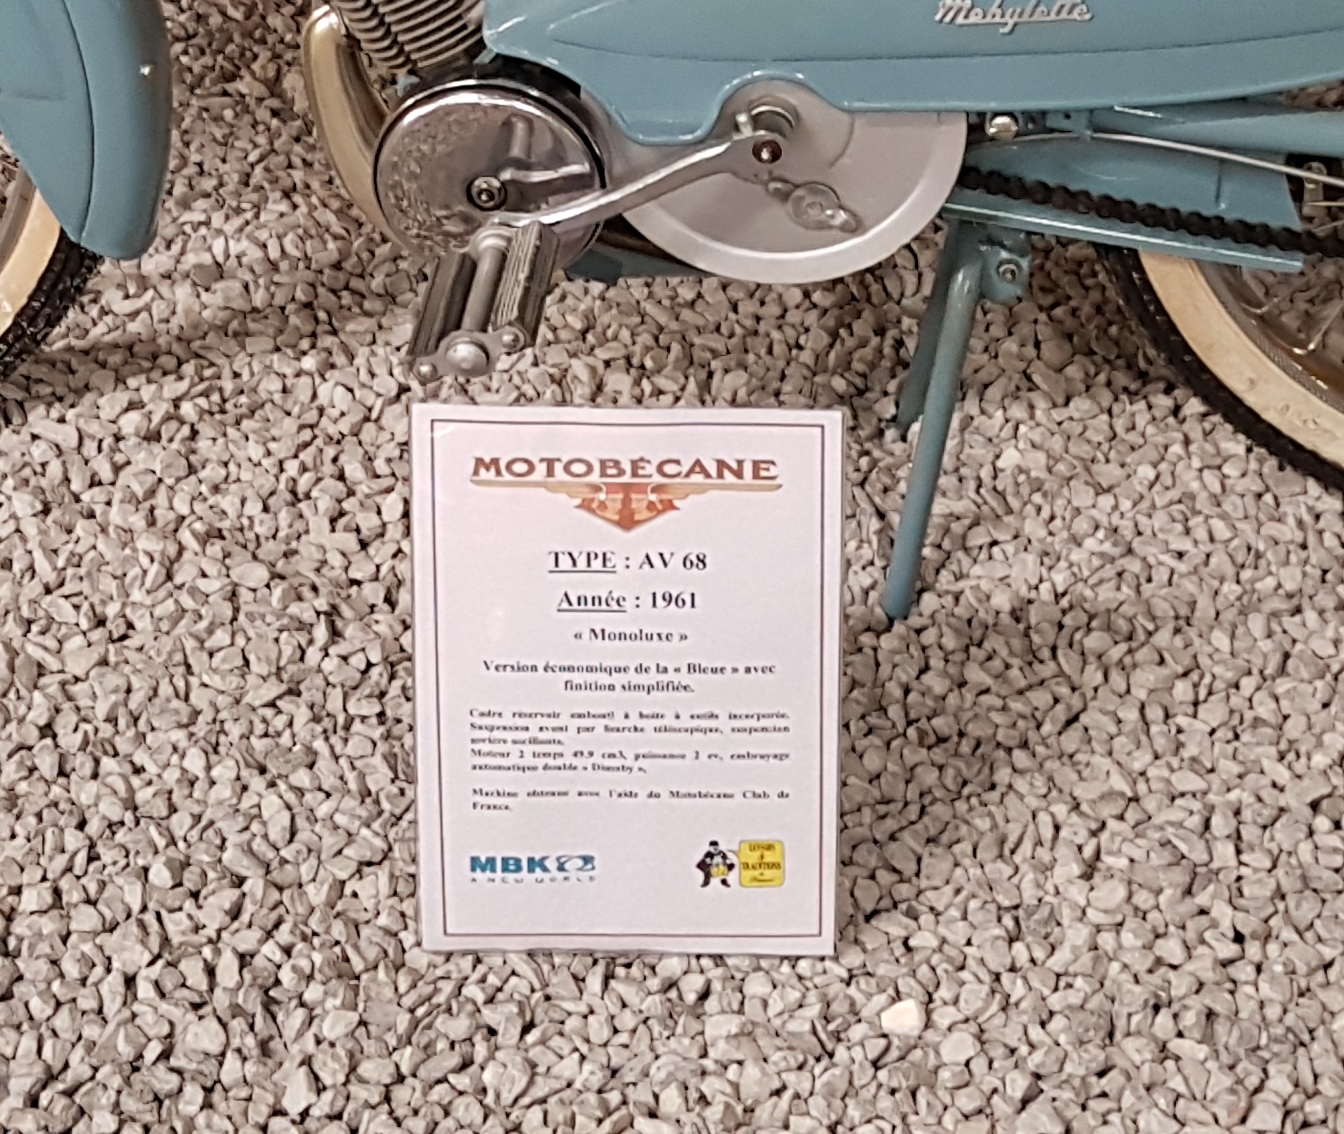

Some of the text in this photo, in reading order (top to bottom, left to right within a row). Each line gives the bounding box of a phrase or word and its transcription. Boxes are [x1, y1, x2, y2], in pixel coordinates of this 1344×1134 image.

[472, 456, 779, 480] MOTOBÉCANE
[548, 551, 616, 571] TYPE
[638, 552, 674, 570] AV
[682, 552, 707, 570] 68
[557, 590, 627, 609] Année
[650, 591, 697, 609] 1961
[589, 628, 673, 642] Monoluxe
[483, 660, 538, 673] Version
[543, 661, 630, 677] économique
[634, 663, 651, 674] de
[656, 663, 668, 674] la
[687, 663, 727, 674] Bleue
[744, 664, 776, 674] avec
[564, 679, 695, 695] finition simplifiée.
[469, 708, 503, 719] Cadre
[512, 709, 561, 719] réservoir
[469, 722, 530, 733] Suspension
[538, 724, 568, 733] avant
[577, 725, 596, 734] par
[603, 724, 645, 733] fourche
[731, 725, 790, 735] suspension
[470, 748, 510, 759] Moteur
[518, 749, 525, 758] 2
[532, 750, 564, 761] temps
[572, 750, 594, 759] 49.9
[634, 750, 686, 762] puissance
[694, 750, 700, 760] 2
[730, 751, 790, 762] embrayage
[471, 762, 539, 774] automatique
[542, 762, 578, 772] double
[472, 787, 519, 798] Machine
[526, 788, 569, 798] obtenue
[577, 790, 600, 798] avec
[647, 790, 661, 799] du
[669, 789, 735, 799] Motobécane
[742, 790, 770, 799] Club
[777, 790, 790, 799] de
[470, 856, 551, 874] MBK
